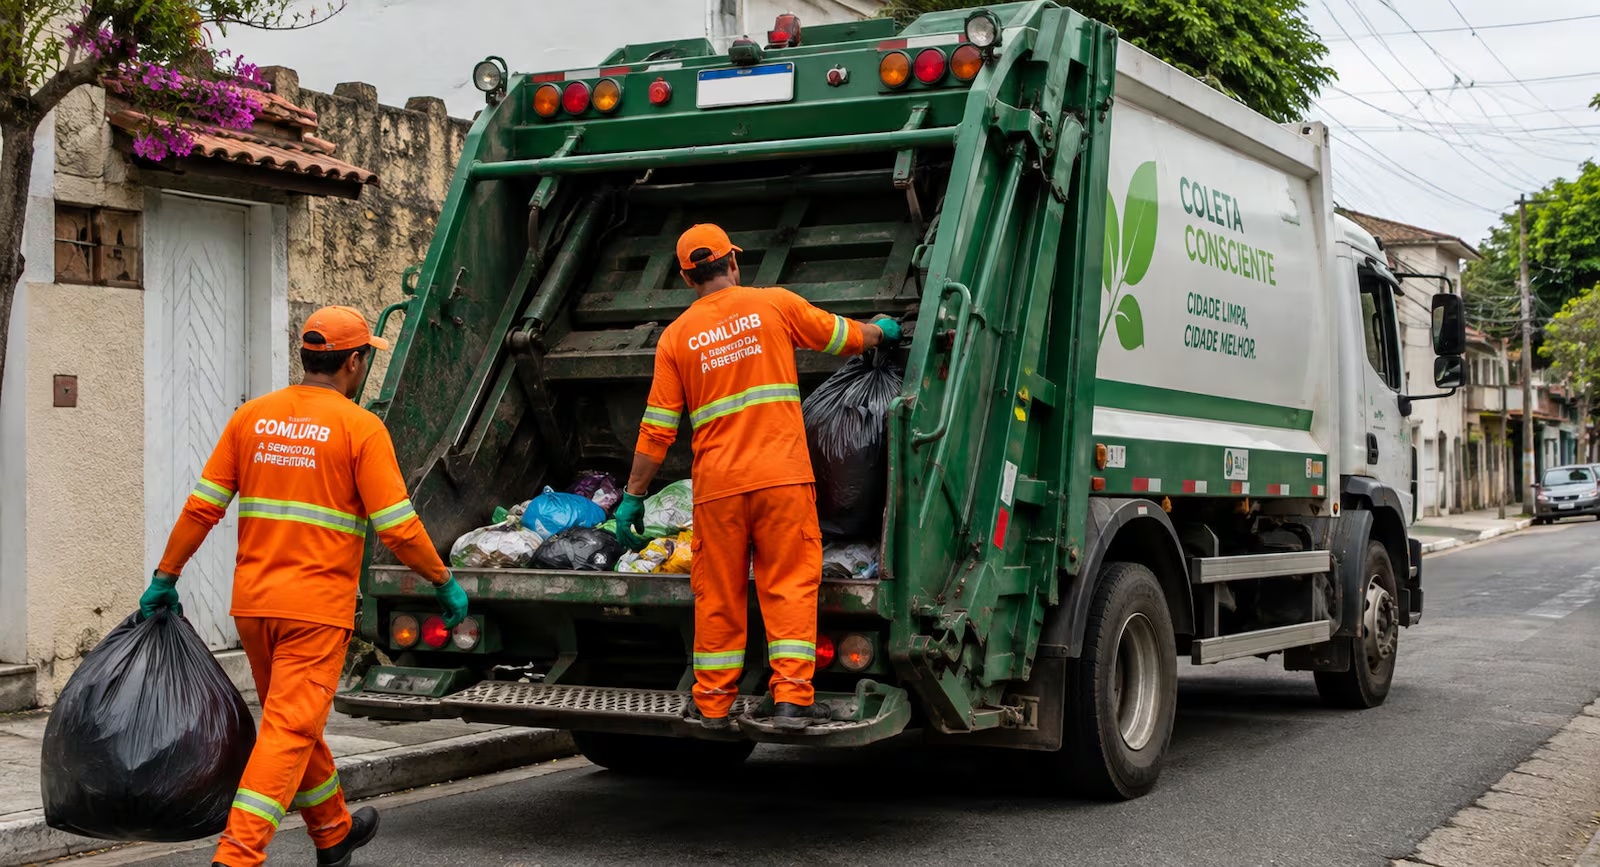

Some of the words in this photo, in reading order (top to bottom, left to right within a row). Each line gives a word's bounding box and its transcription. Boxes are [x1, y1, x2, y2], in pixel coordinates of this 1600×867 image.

[1180, 176, 1244, 234] COLETA
[1185, 224, 1276, 286] CONSCIENTE
[1187, 292, 1220, 321] CIDADE
[1222, 301, 1248, 330] LIMPA,
[688, 313, 761, 350] COMLURB
[1184, 324, 1218, 352] CIDADE
[1220, 332, 1256, 359] MELHOR.
[254, 418, 331, 442] COMLURB
